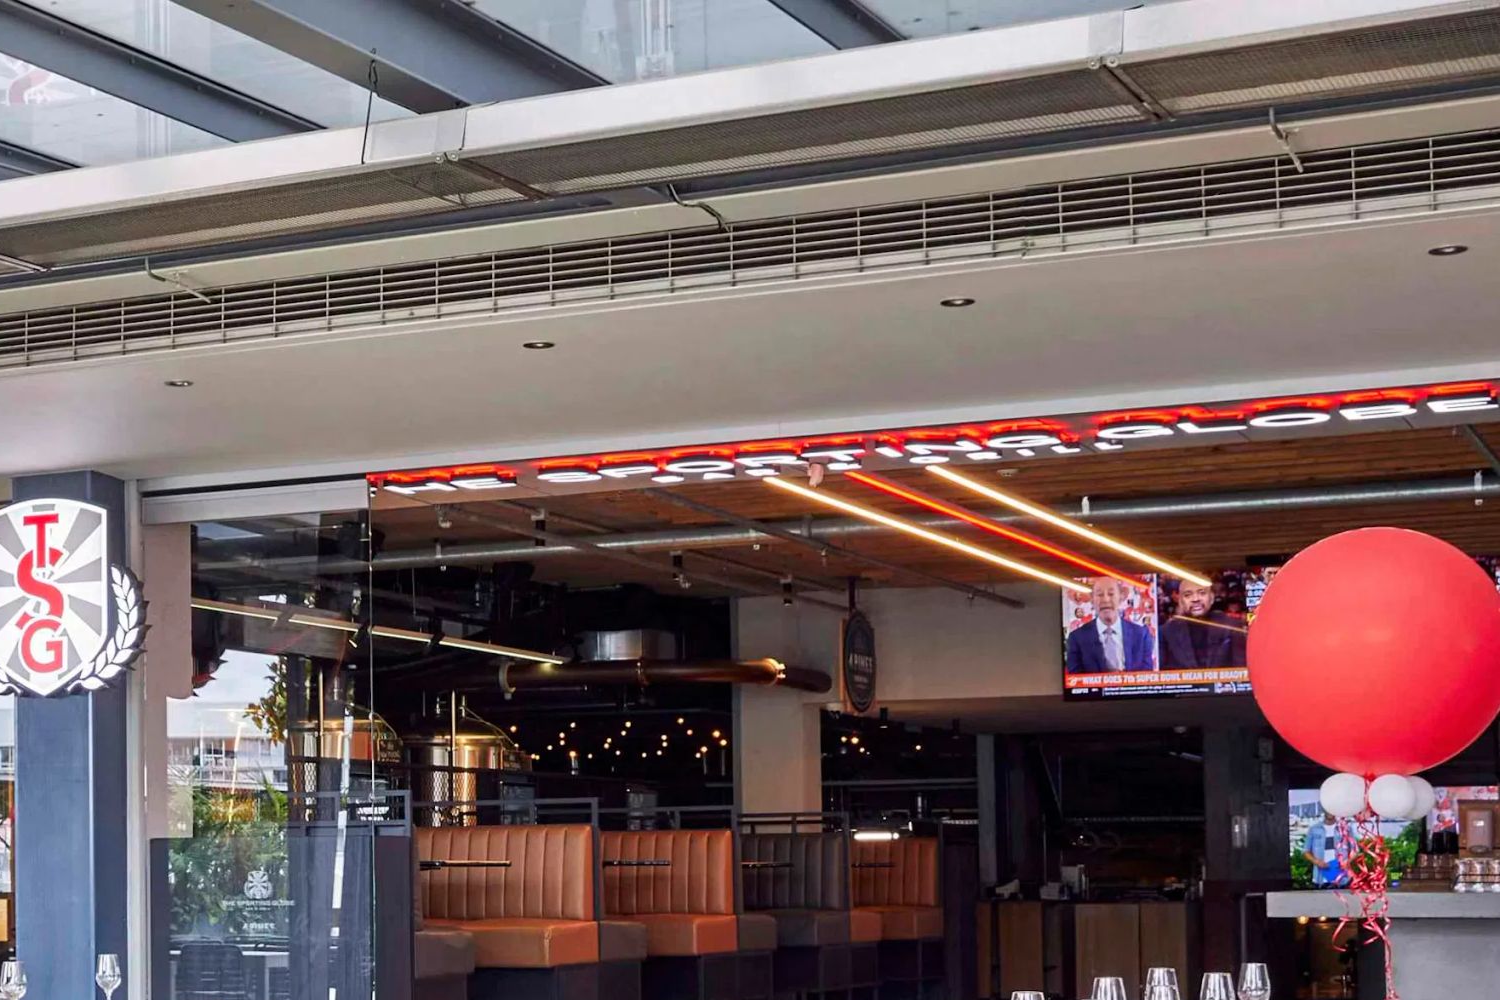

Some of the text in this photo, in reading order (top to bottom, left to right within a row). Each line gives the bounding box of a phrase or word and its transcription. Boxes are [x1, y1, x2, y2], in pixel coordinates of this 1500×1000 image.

[369, 396, 1499, 497] HE SPORTING GLOBE
